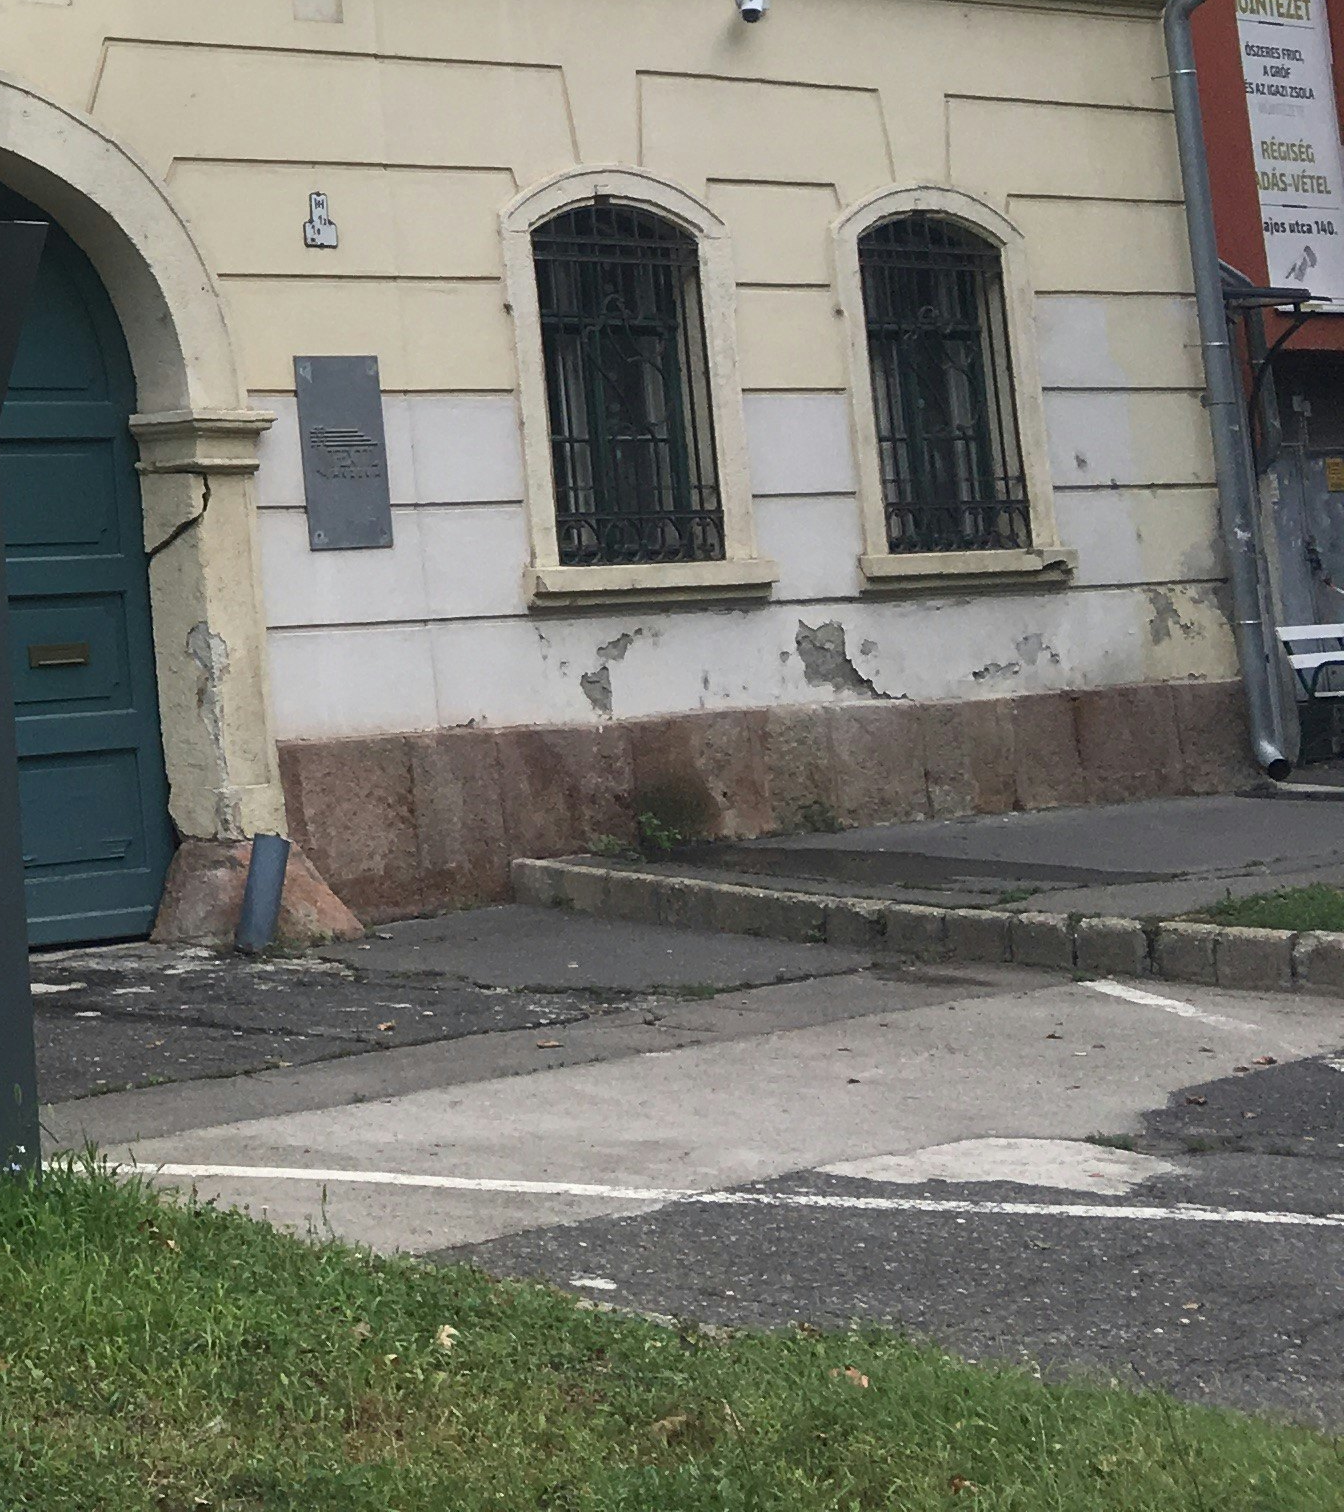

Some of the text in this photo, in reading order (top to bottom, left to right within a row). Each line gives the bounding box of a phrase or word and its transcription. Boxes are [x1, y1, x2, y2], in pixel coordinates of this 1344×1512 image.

[1263, 64, 1291, 78] A GRÓF
[1245, 79, 1254, 94] ÉS
[1255, 83, 1266, 95] AZ
[1267, 84, 1288, 97] IGAZI
[1261, 136, 1315, 164] RÉGISÉG
[1262, 217, 1338, 236] ajos utca 140.
